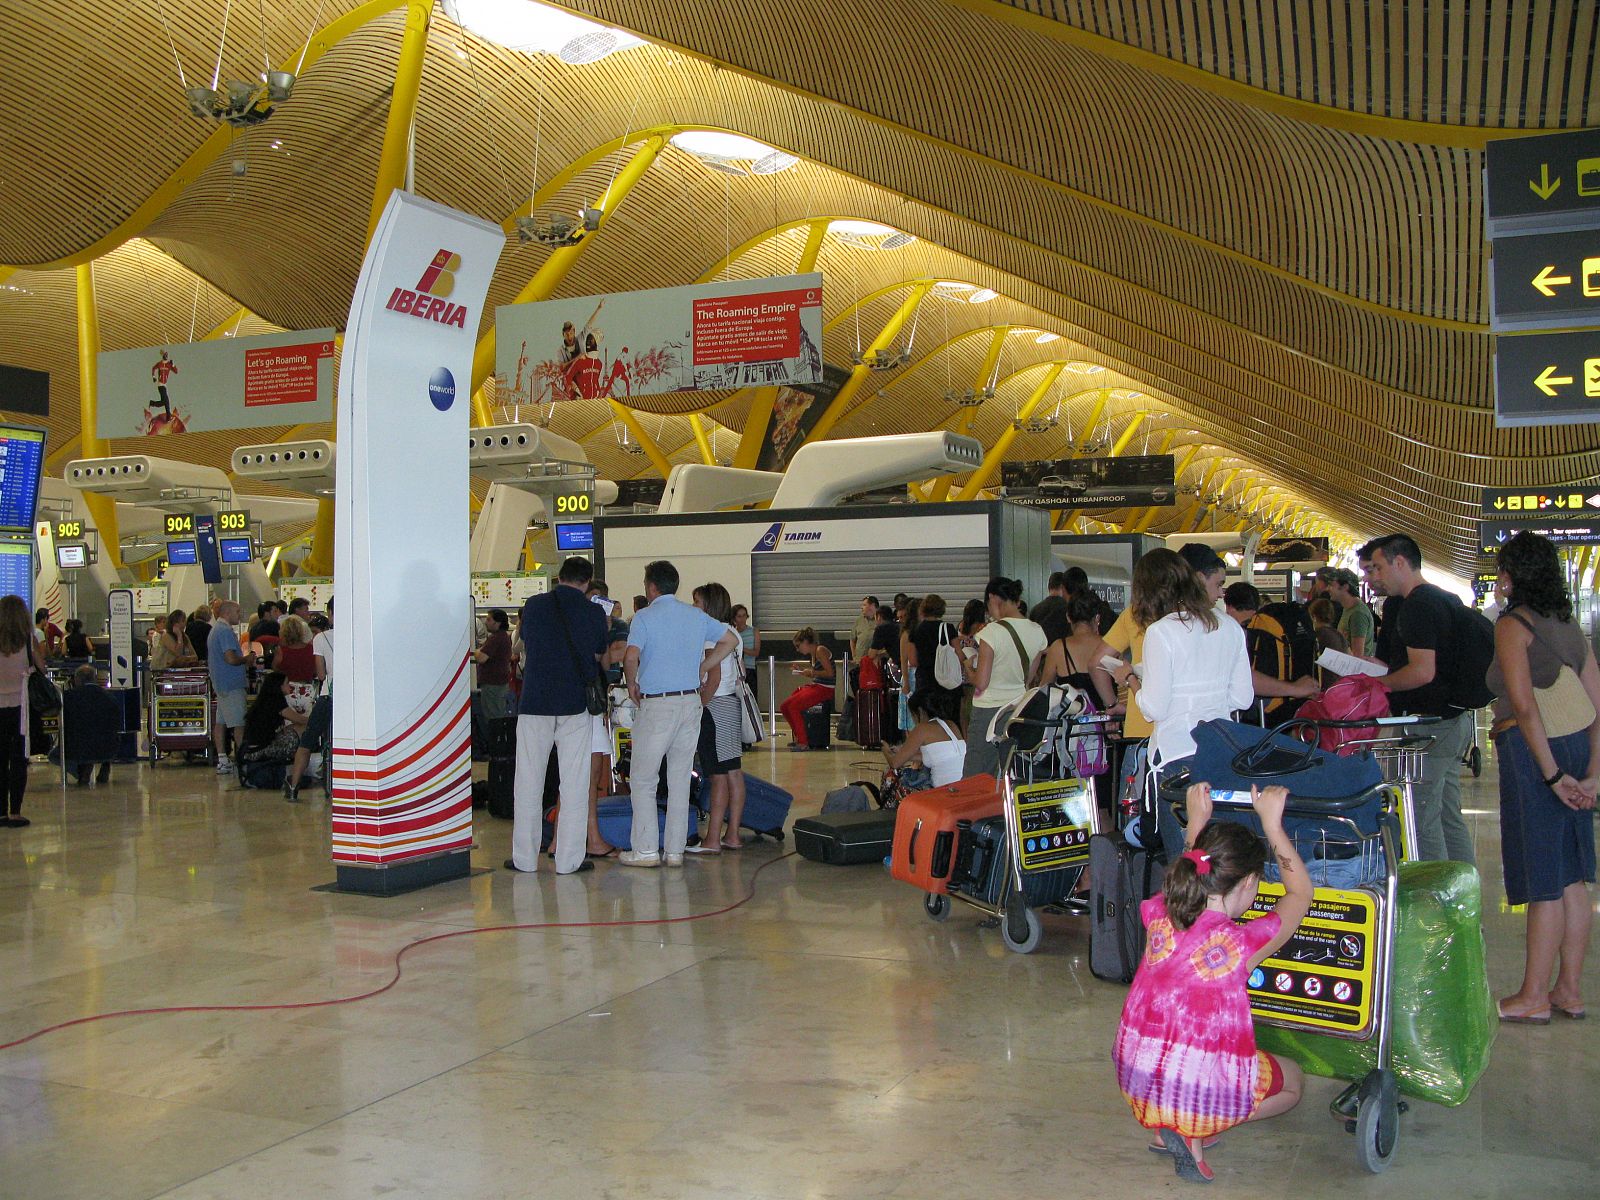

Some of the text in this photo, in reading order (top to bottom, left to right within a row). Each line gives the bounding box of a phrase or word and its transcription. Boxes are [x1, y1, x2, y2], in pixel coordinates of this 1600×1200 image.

[386, 287, 467, 328] IBERIA
[697, 303, 796, 320] The Roaming Empire
[248, 355, 307, 368] Let's go Roaming
[430, 384, 454, 395] oneworld
[557, 495, 589, 512] 900
[167, 517, 191, 532] 904
[221, 514, 245, 529] 903
[59, 522, 80, 537] 905
[784, 532, 822, 541] TAROM
[1319, 903, 1350, 911] pasajeros
[1310, 910, 1344, 920] passengers
